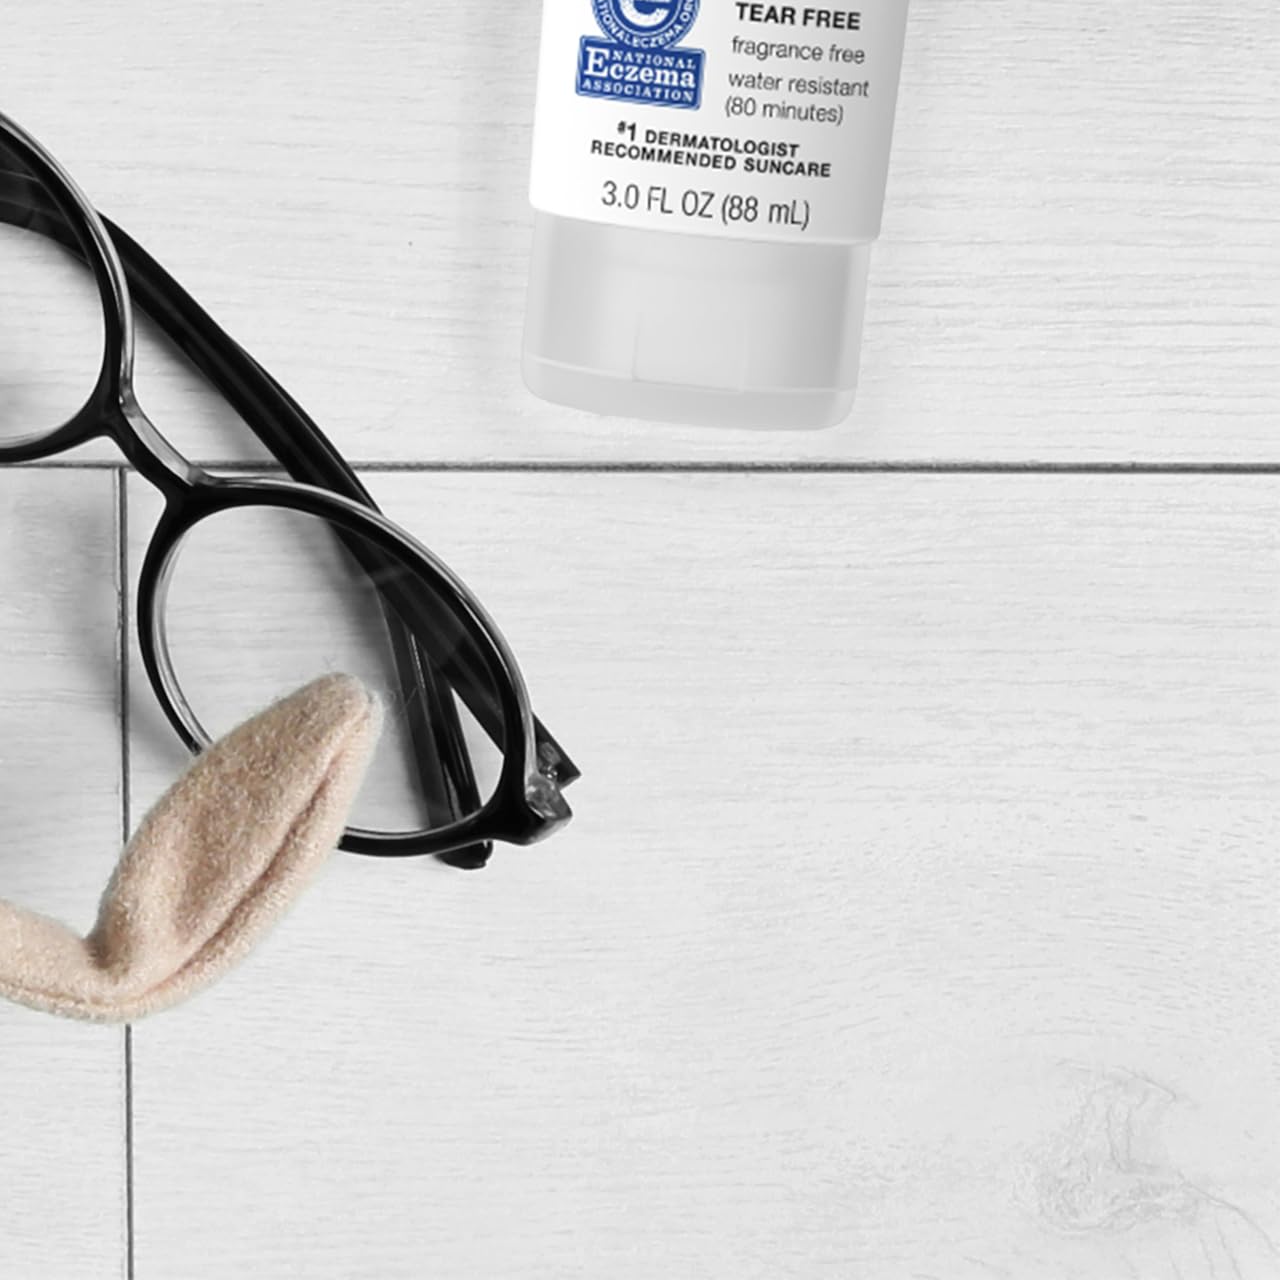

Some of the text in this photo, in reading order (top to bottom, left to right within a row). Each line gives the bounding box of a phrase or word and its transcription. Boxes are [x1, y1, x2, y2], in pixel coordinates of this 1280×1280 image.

[735, 2, 861, 31] TEAR FREE
[612, 50, 696, 70] NATIONAL
[732, 35, 865, 65] fragrance free
[584, 46, 696, 89] Eczema
[582, 79, 695, 102] ASSOCIATION
[728, 72, 870, 98] water resistant
[724, 95, 844, 126] (80 minutes)
[617, 121, 800, 158] #1 DERMATOLOGIST
[590, 139, 832, 178] RECOMMENDED SUNCARE
[601, 180, 811, 231] 3.0 FL OZ (88 mL)
